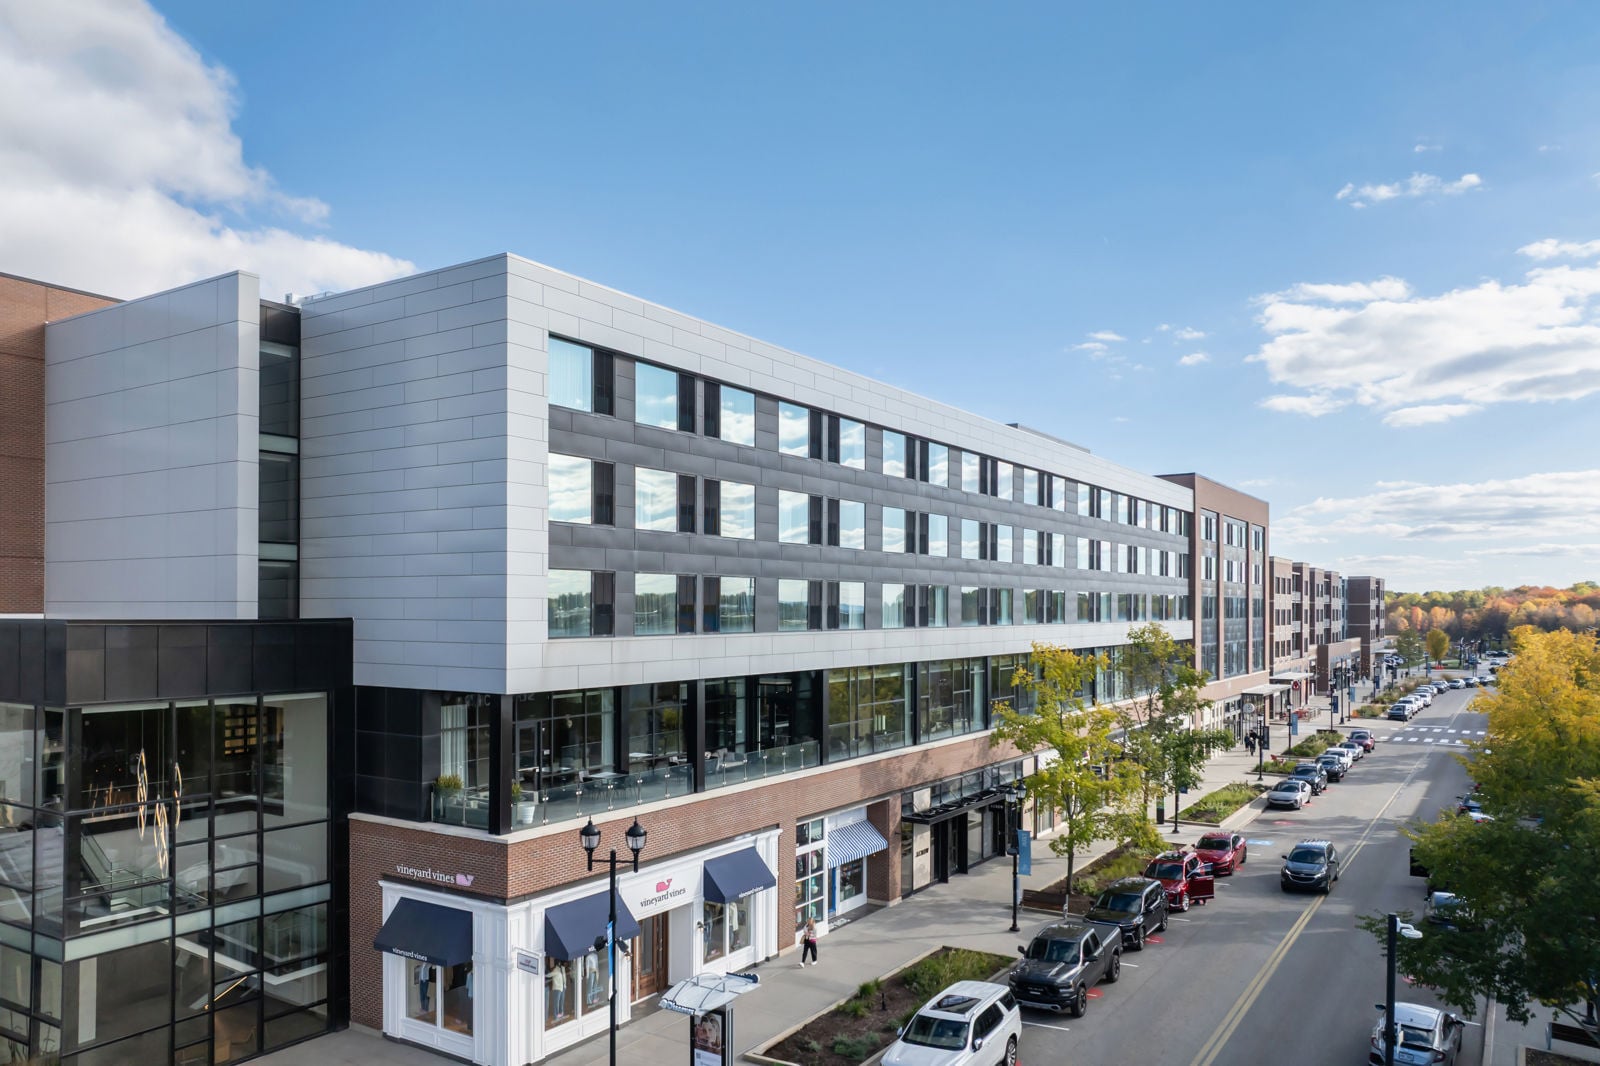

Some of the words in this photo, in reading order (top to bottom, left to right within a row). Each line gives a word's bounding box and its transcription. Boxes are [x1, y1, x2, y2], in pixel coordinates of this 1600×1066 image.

[396, 864, 431, 879] vineyard
[431, 870, 455, 884] vines
[640, 891, 669, 907] vineyard
[669, 888, 686, 898] vines
